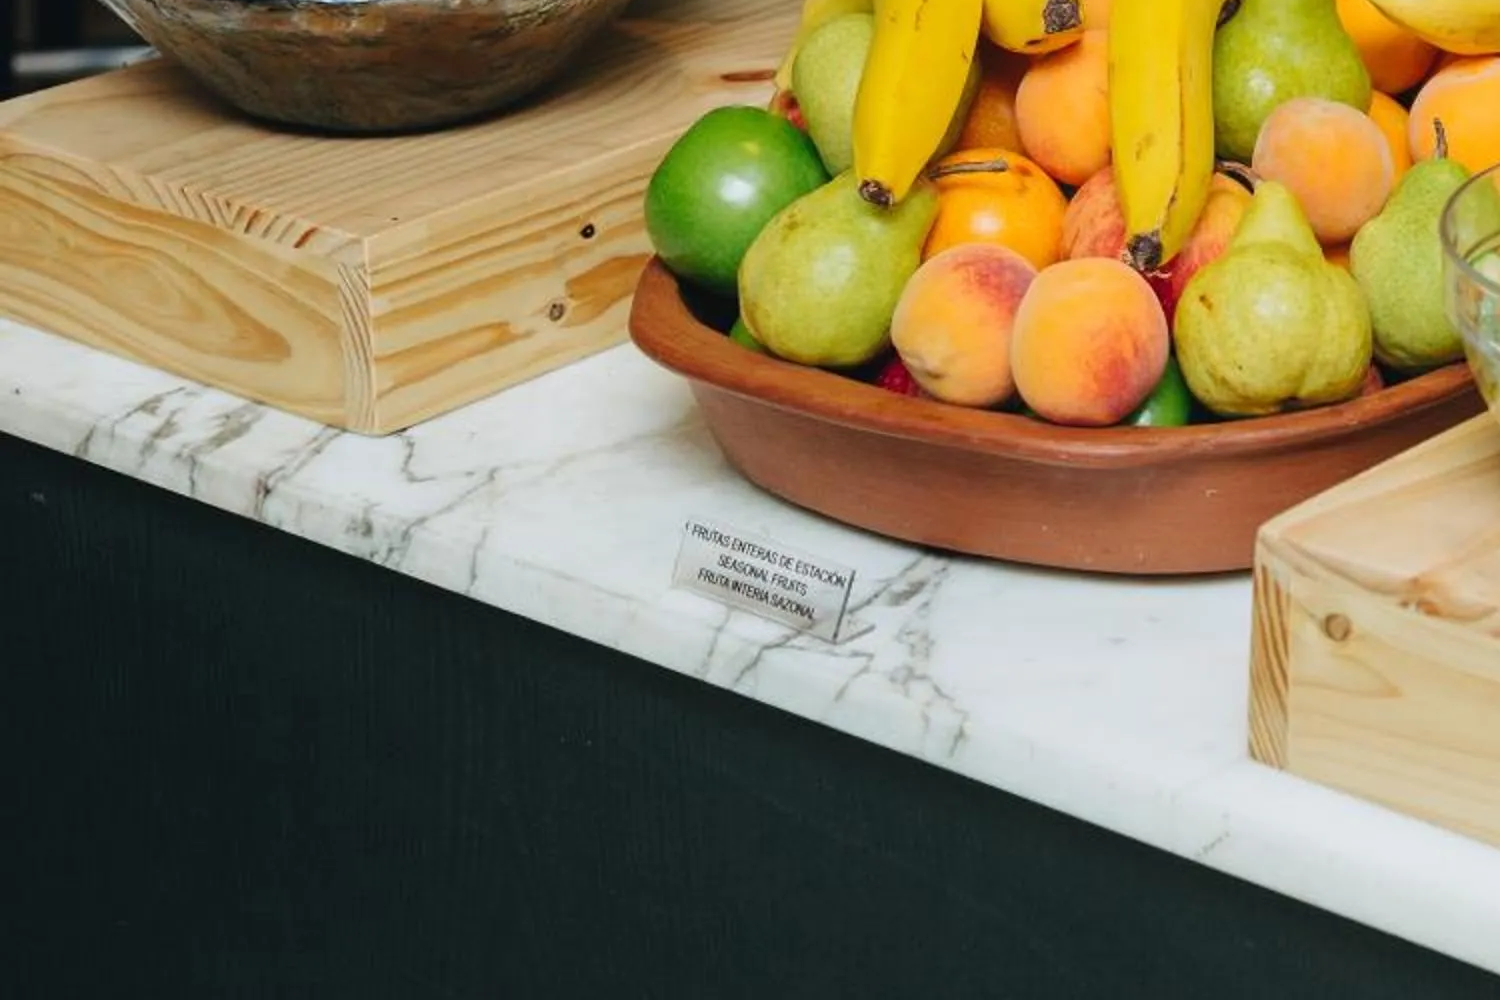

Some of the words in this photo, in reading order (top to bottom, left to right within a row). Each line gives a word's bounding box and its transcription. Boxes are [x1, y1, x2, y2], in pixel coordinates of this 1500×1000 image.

[691, 523, 731, 547] FRUTAS
[731, 537, 779, 565] ENTERAS
[778, 553, 795, 571] DE
[795, 560, 848, 589] ESTACIÓN
[717, 553, 769, 583] SEASONAL
[771, 572, 809, 597] FRUITS
[697, 567, 729, 587] FRUTA
[769, 593, 816, 621] SAZONAL
